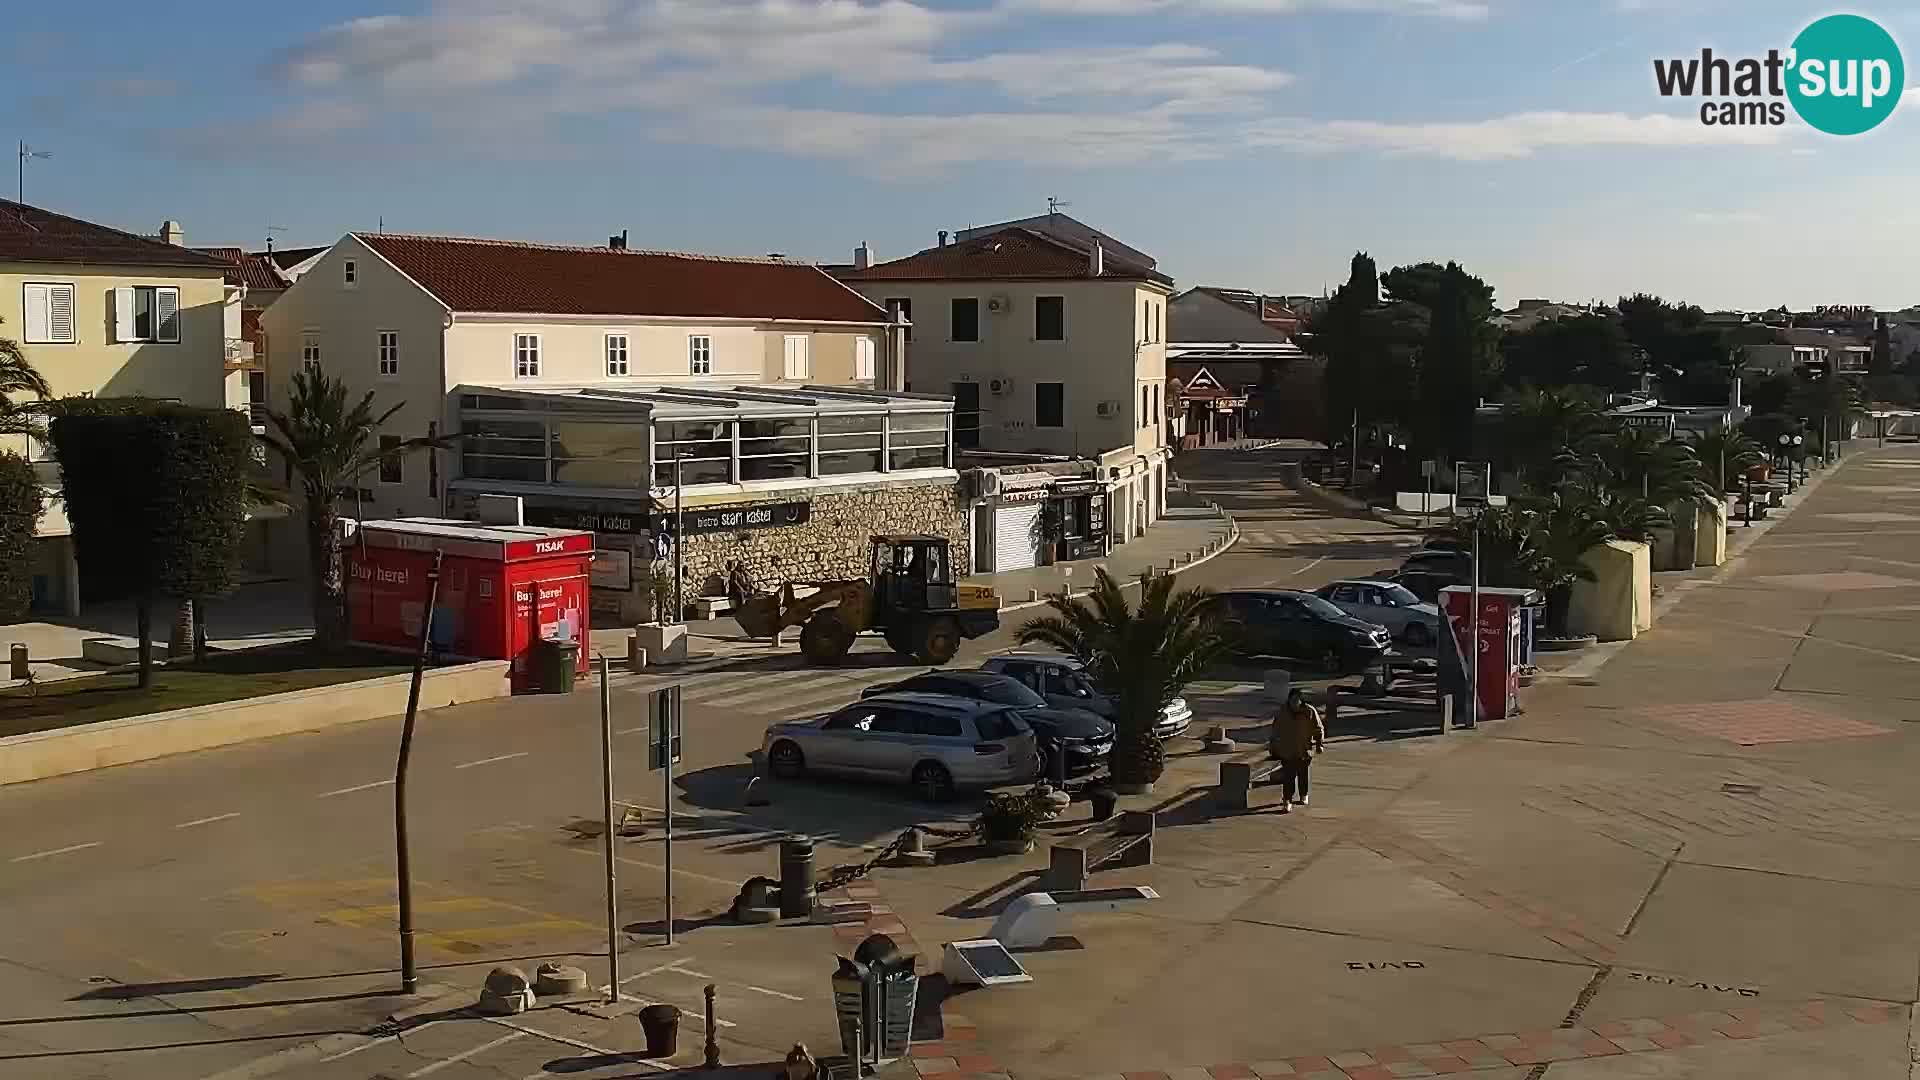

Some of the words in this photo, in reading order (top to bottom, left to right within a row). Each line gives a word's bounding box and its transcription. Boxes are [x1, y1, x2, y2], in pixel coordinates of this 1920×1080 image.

[535, 540, 565, 553] TISAK
[376, 564, 409, 584] here!
[539, 585, 563, 600] here!
